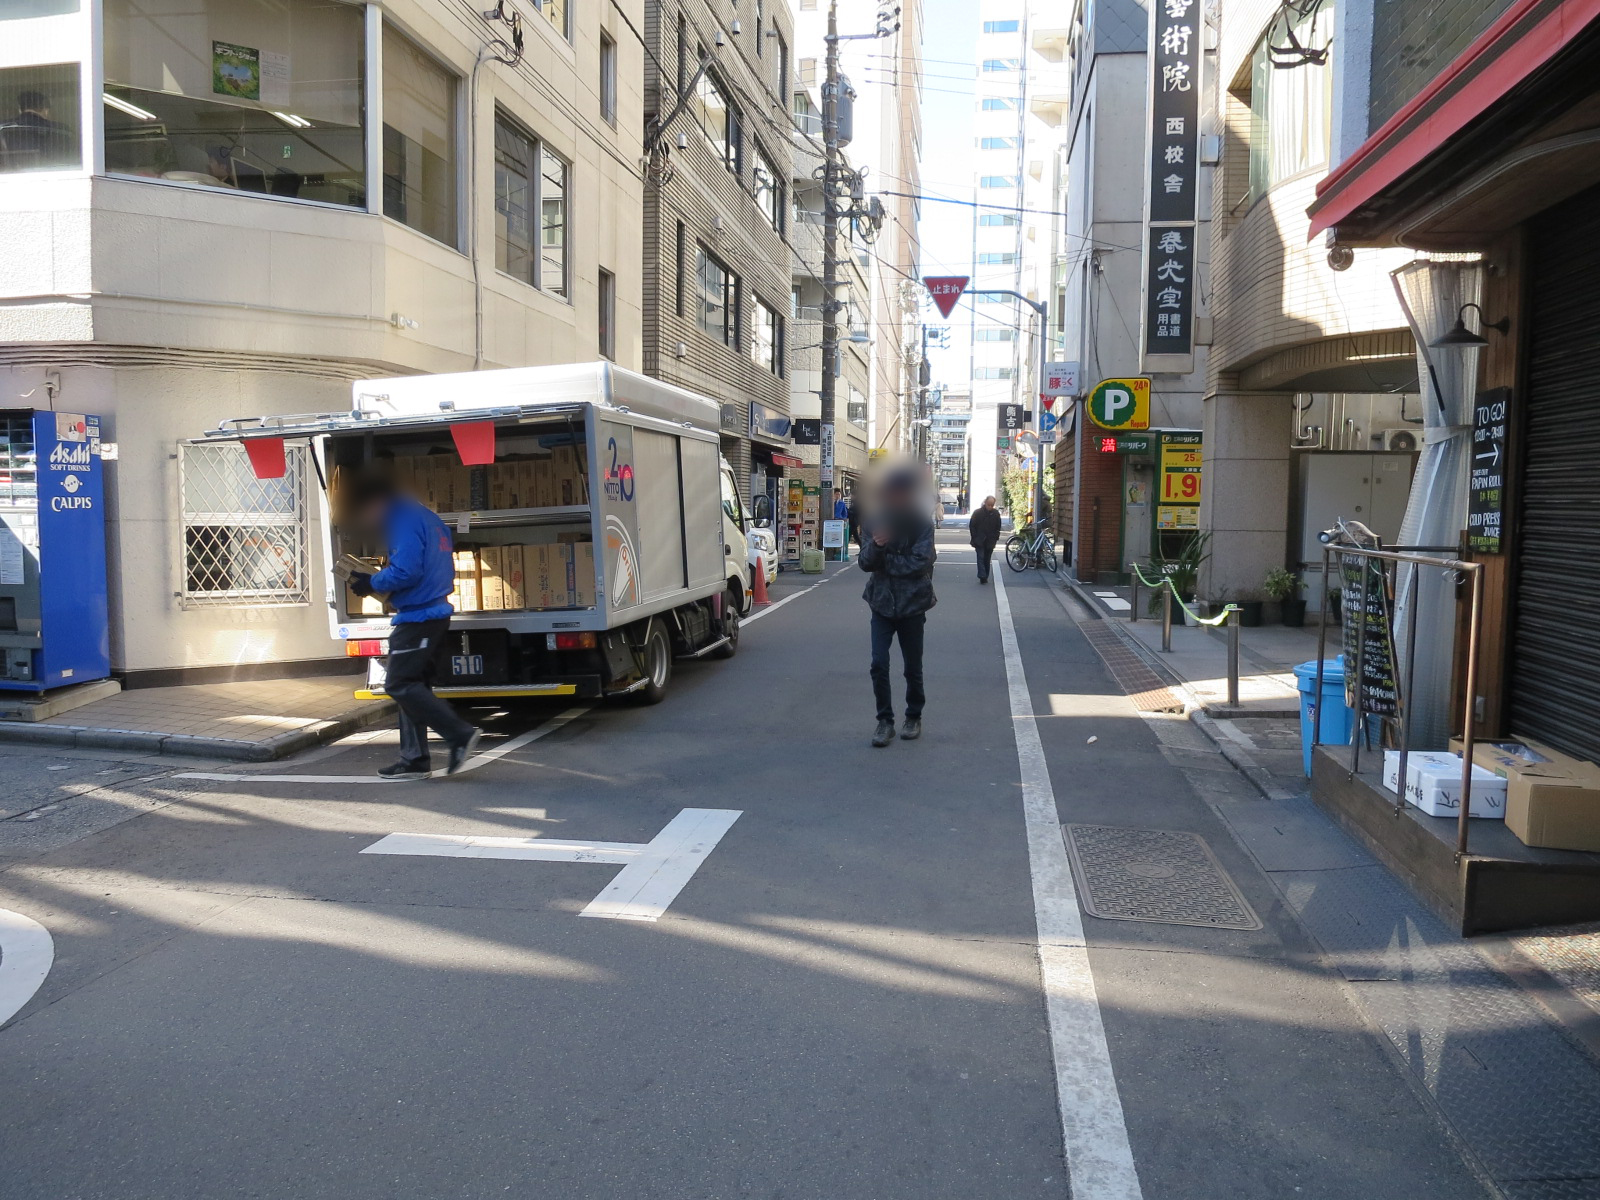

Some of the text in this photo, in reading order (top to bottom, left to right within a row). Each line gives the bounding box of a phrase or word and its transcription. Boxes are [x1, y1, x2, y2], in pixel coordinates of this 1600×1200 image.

[1163, 117, 1185, 193] 西校舎
[932, 284, 961, 294] 止まれ
[1104, 389, 1130, 421] P
[1477, 400, 1506, 426] TO GO!
[49, 442, 91, 465] Asahi
[1101, 438, 1116, 453] 満
[67, 464, 91, 472] DRINKS
[51, 496, 92, 512] CALPIS
[453, 655, 482, 674] 510
